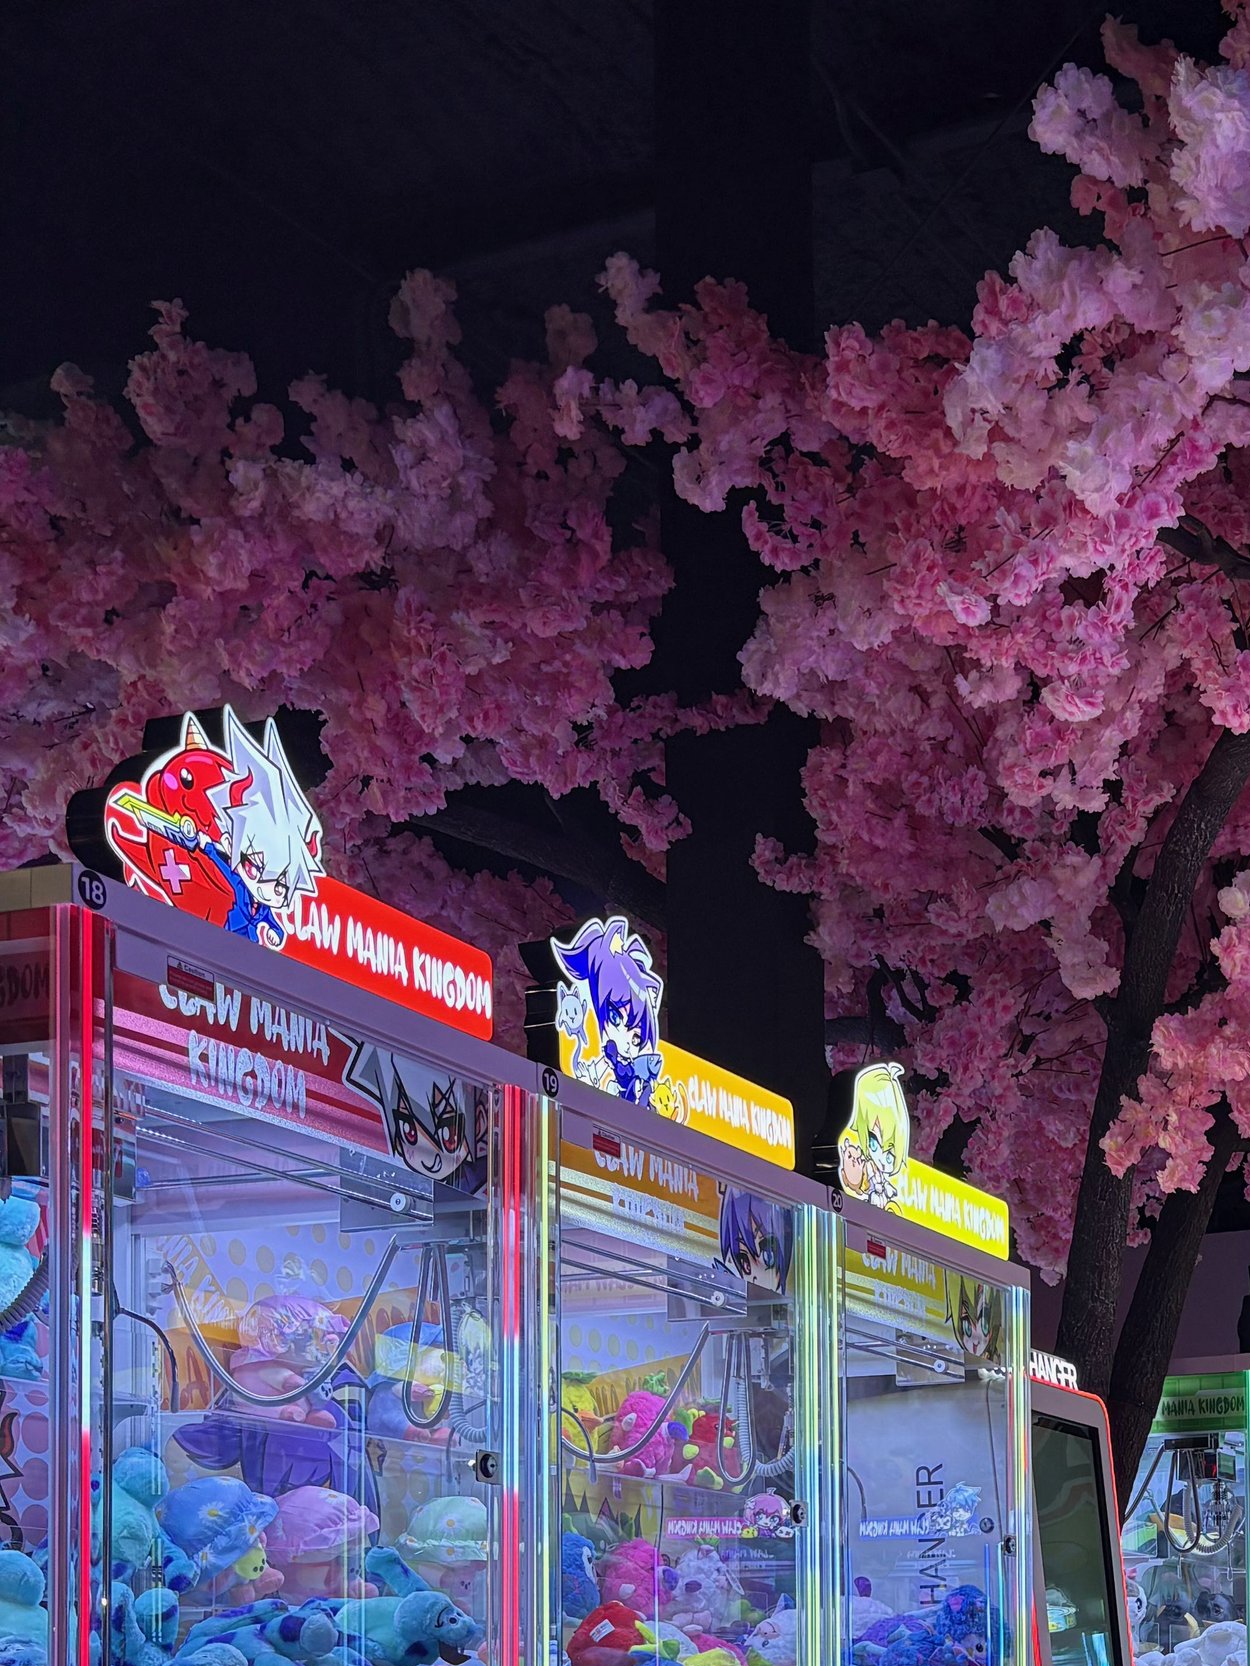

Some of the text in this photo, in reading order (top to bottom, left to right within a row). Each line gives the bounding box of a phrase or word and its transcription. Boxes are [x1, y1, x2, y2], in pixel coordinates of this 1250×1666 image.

[80, 877, 104, 901] 18
[346, 921, 409, 987] MANIA
[413, 946, 492, 1020] KINGDOM
[251, 992, 331, 1065] MANIA
[188, 1029, 306, 1119] KINGDOM
[544, 1073, 558, 1091] 19
[687, 1075, 792, 1150] CLAW MANIA KINGDOM
[650, 1154, 698, 1202] MANIA
[833, 1193, 843, 1209] 20
[931, 1185, 962, 1229] MANIA
[963, 1201, 1006, 1245] KINGDOM
[901, 1252, 936, 1292] MANIA
[1029, 1351, 1079, 1391] HANGER
[1162, 1397, 1196, 1417] MANIA
[1199, 1394, 1246, 1415] KINGDOM
